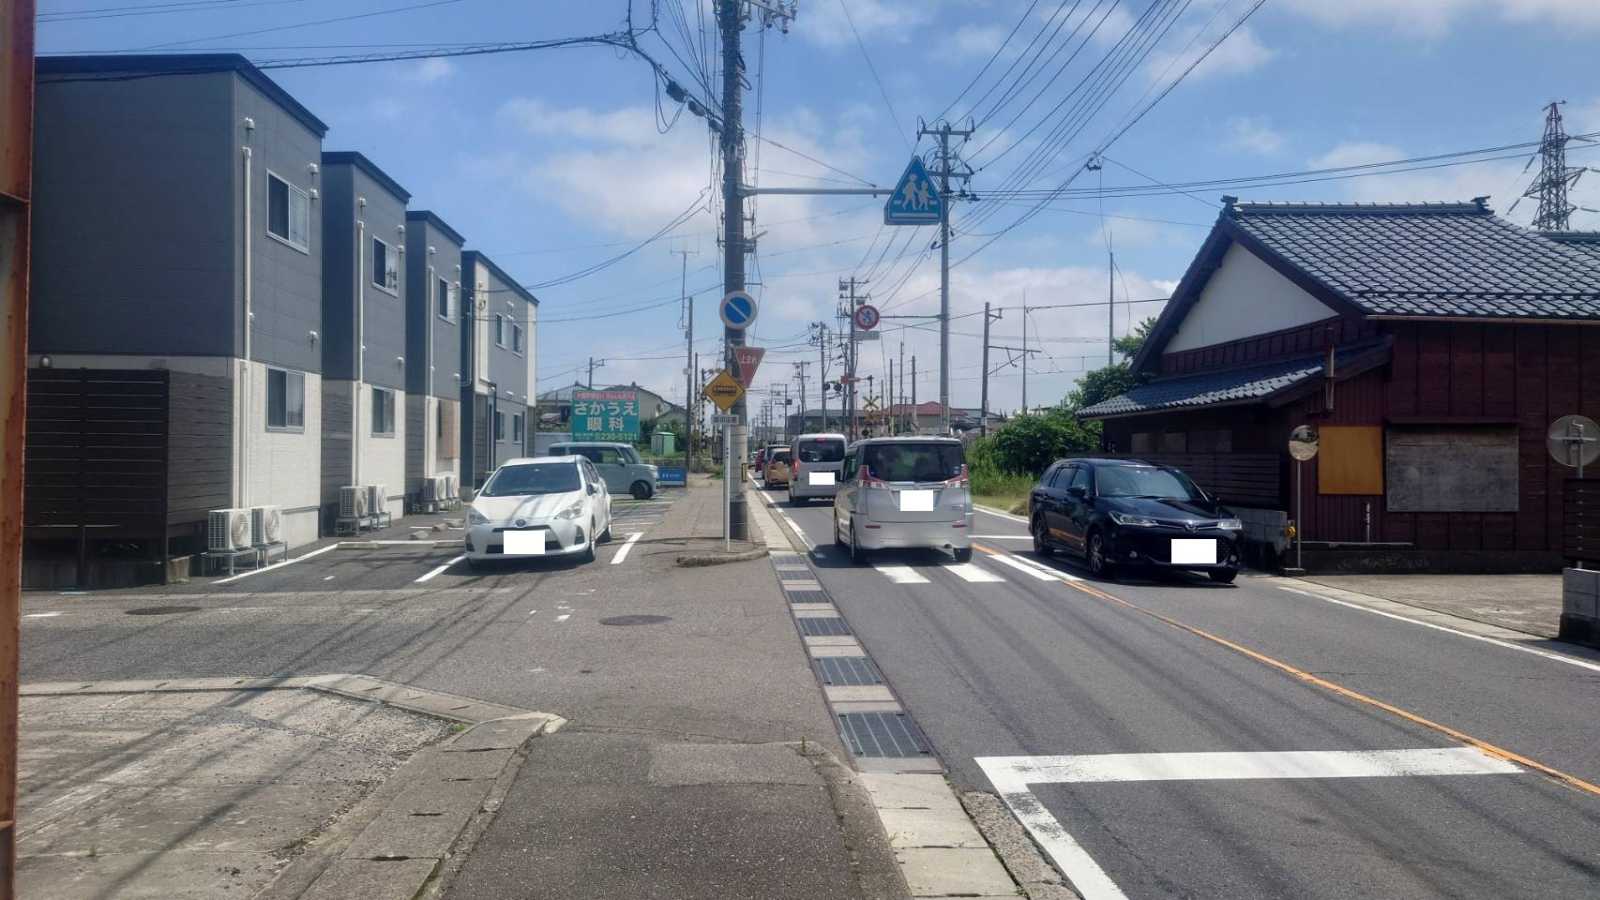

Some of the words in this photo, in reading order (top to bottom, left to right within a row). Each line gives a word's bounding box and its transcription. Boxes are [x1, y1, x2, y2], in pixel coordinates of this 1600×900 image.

[574, 401, 638, 416] さかうえ
[587, 416, 625, 432] 眼科
